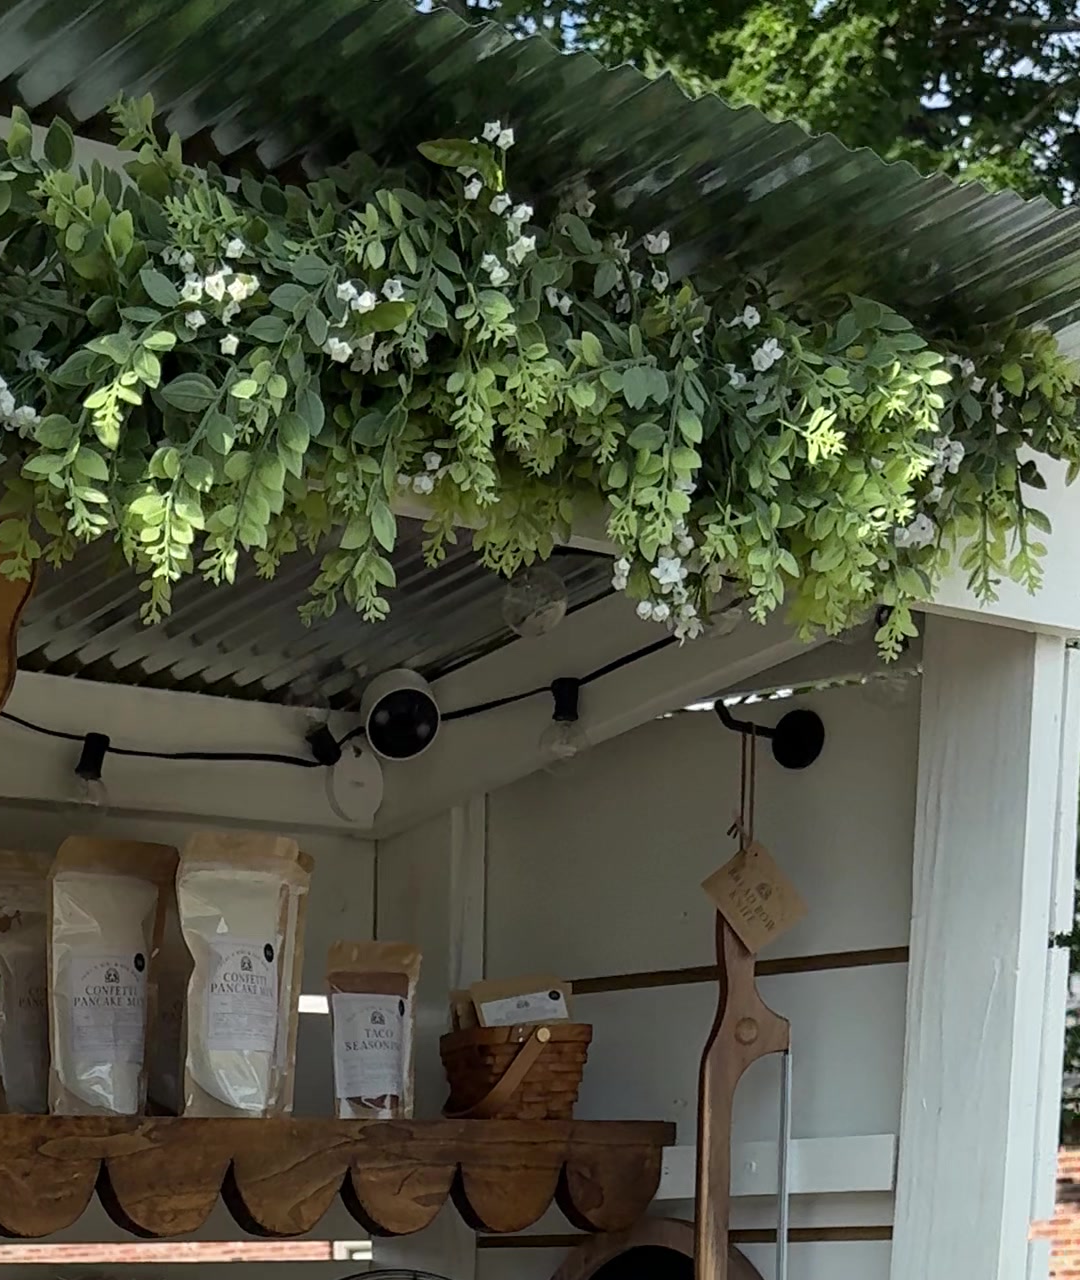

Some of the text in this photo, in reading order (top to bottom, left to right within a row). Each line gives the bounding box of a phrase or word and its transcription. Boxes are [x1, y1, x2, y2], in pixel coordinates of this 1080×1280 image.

[210, 982, 258, 995] PANCAKE
[73, 996, 123, 1007] PANCAKE
[364, 1028, 394, 1039] TACO
